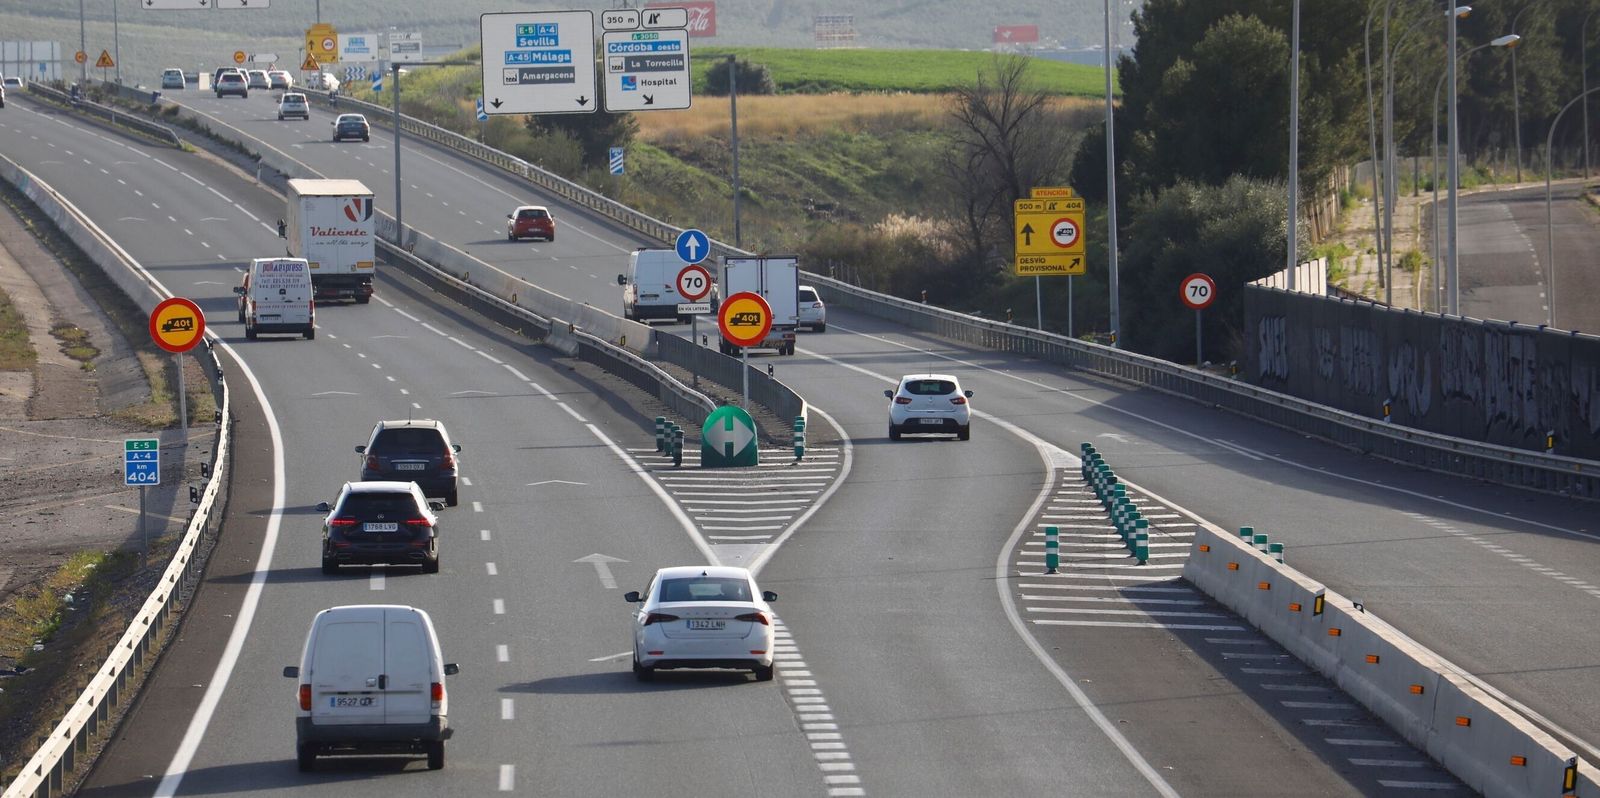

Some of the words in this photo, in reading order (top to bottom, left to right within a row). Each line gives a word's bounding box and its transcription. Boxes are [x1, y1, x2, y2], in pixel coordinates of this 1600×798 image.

[607, 16, 624, 24] 350
[520, 37, 555, 46] Sevilla
[609, 43, 653, 52] Córdoba
[657, 43, 680, 51] oeste
[508, 53, 530, 62] A-45
[532, 52, 570, 63] Málaga
[645, 59, 683, 67] Torrecilla
[522, 72, 575, 81] Amargacena
[641, 78, 677, 87] Hospital
[310, 226, 368, 237] Valiente
[684, 277, 703, 288] 70
[1190, 285, 1208, 297] 70
[741, 314, 758, 322] 40t
[173, 319, 191, 327] 40t
[128, 471, 157, 482] 404
[691, 620, 710, 628] 1342
[711, 620, 726, 628] LNH
[337, 697, 358, 706] 9527
